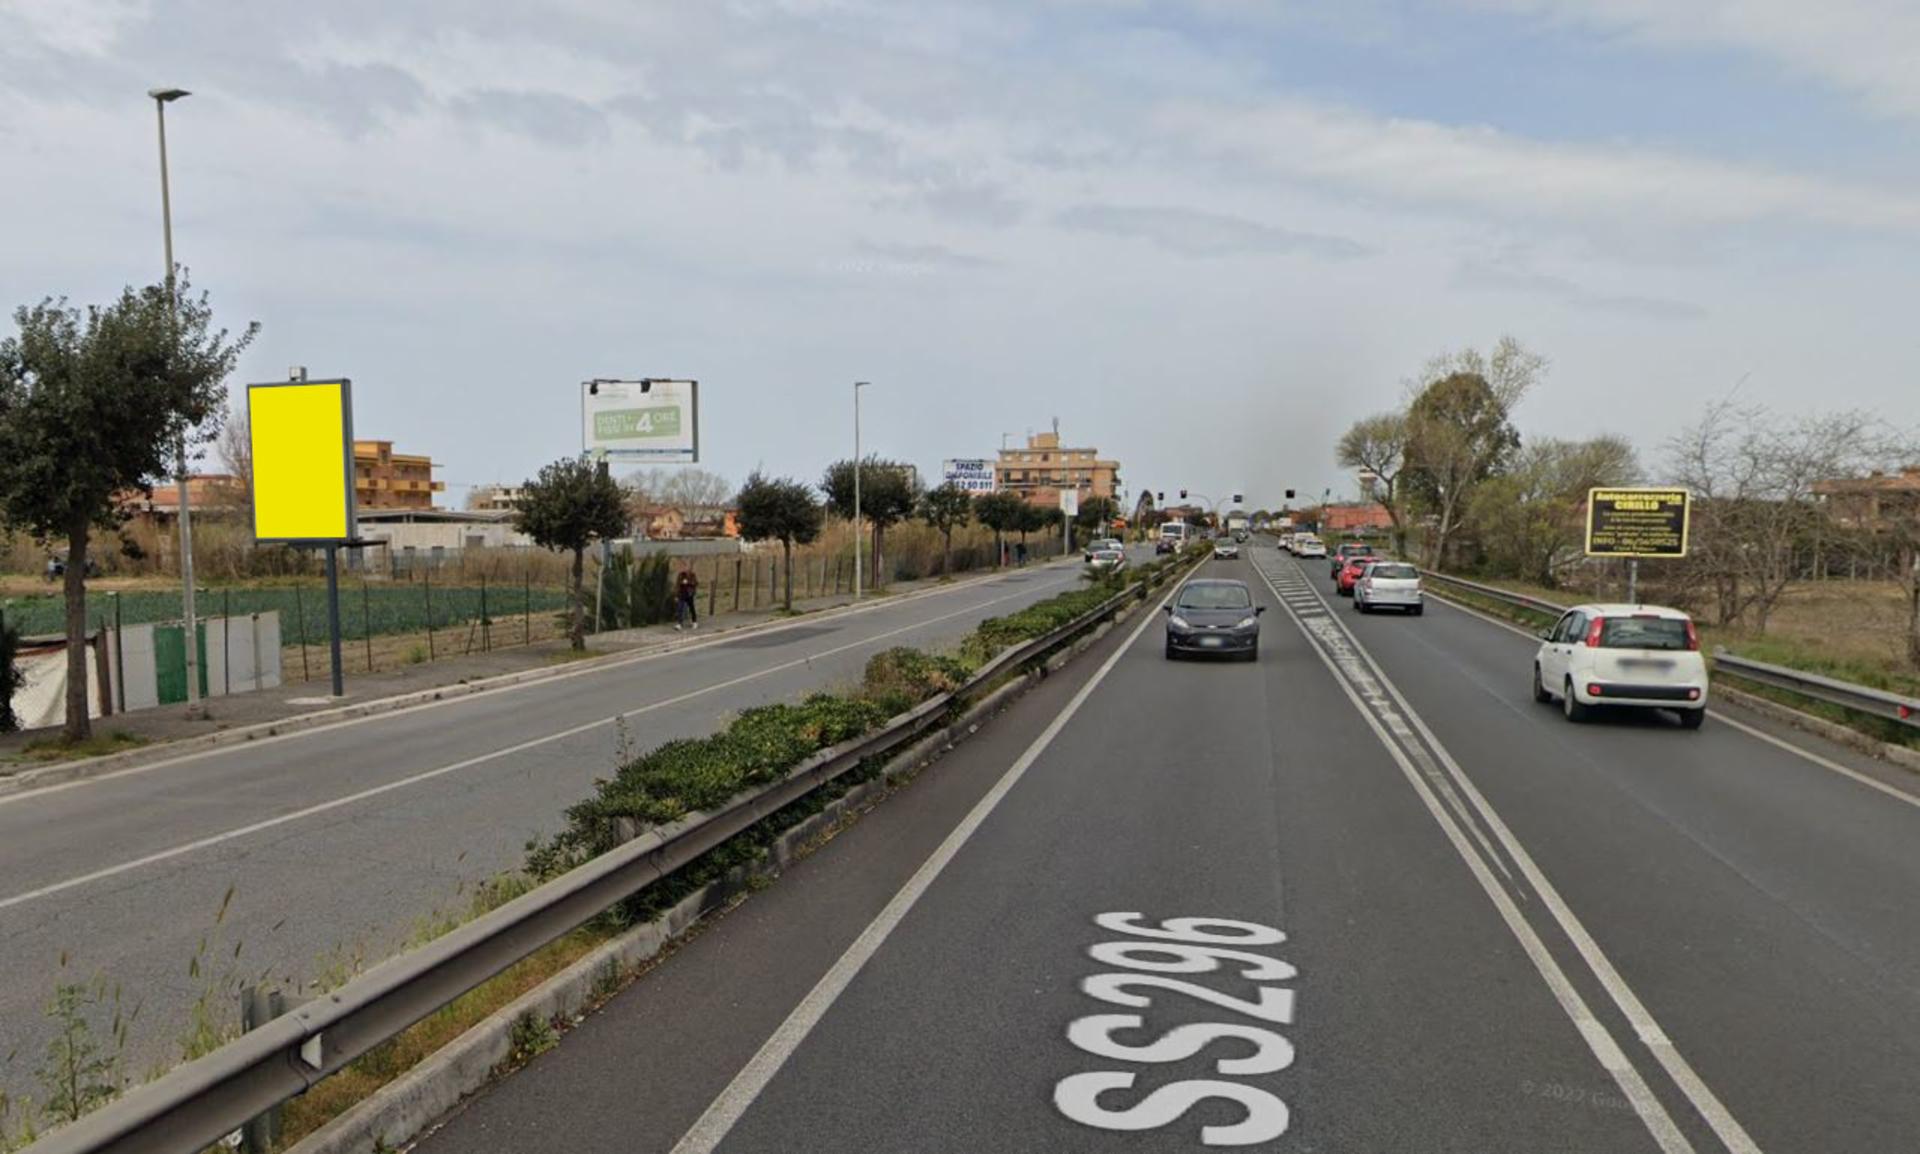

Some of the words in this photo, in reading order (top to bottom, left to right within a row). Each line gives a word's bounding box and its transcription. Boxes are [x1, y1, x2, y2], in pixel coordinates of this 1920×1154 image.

[636, 412, 654, 433] 4
[956, 462, 984, 470] SPAZIO
[945, 471, 993, 480] DISPONIBILE
[1614, 501, 1659, 510] CIRILLO
[1592, 537, 1616, 545] INFO
